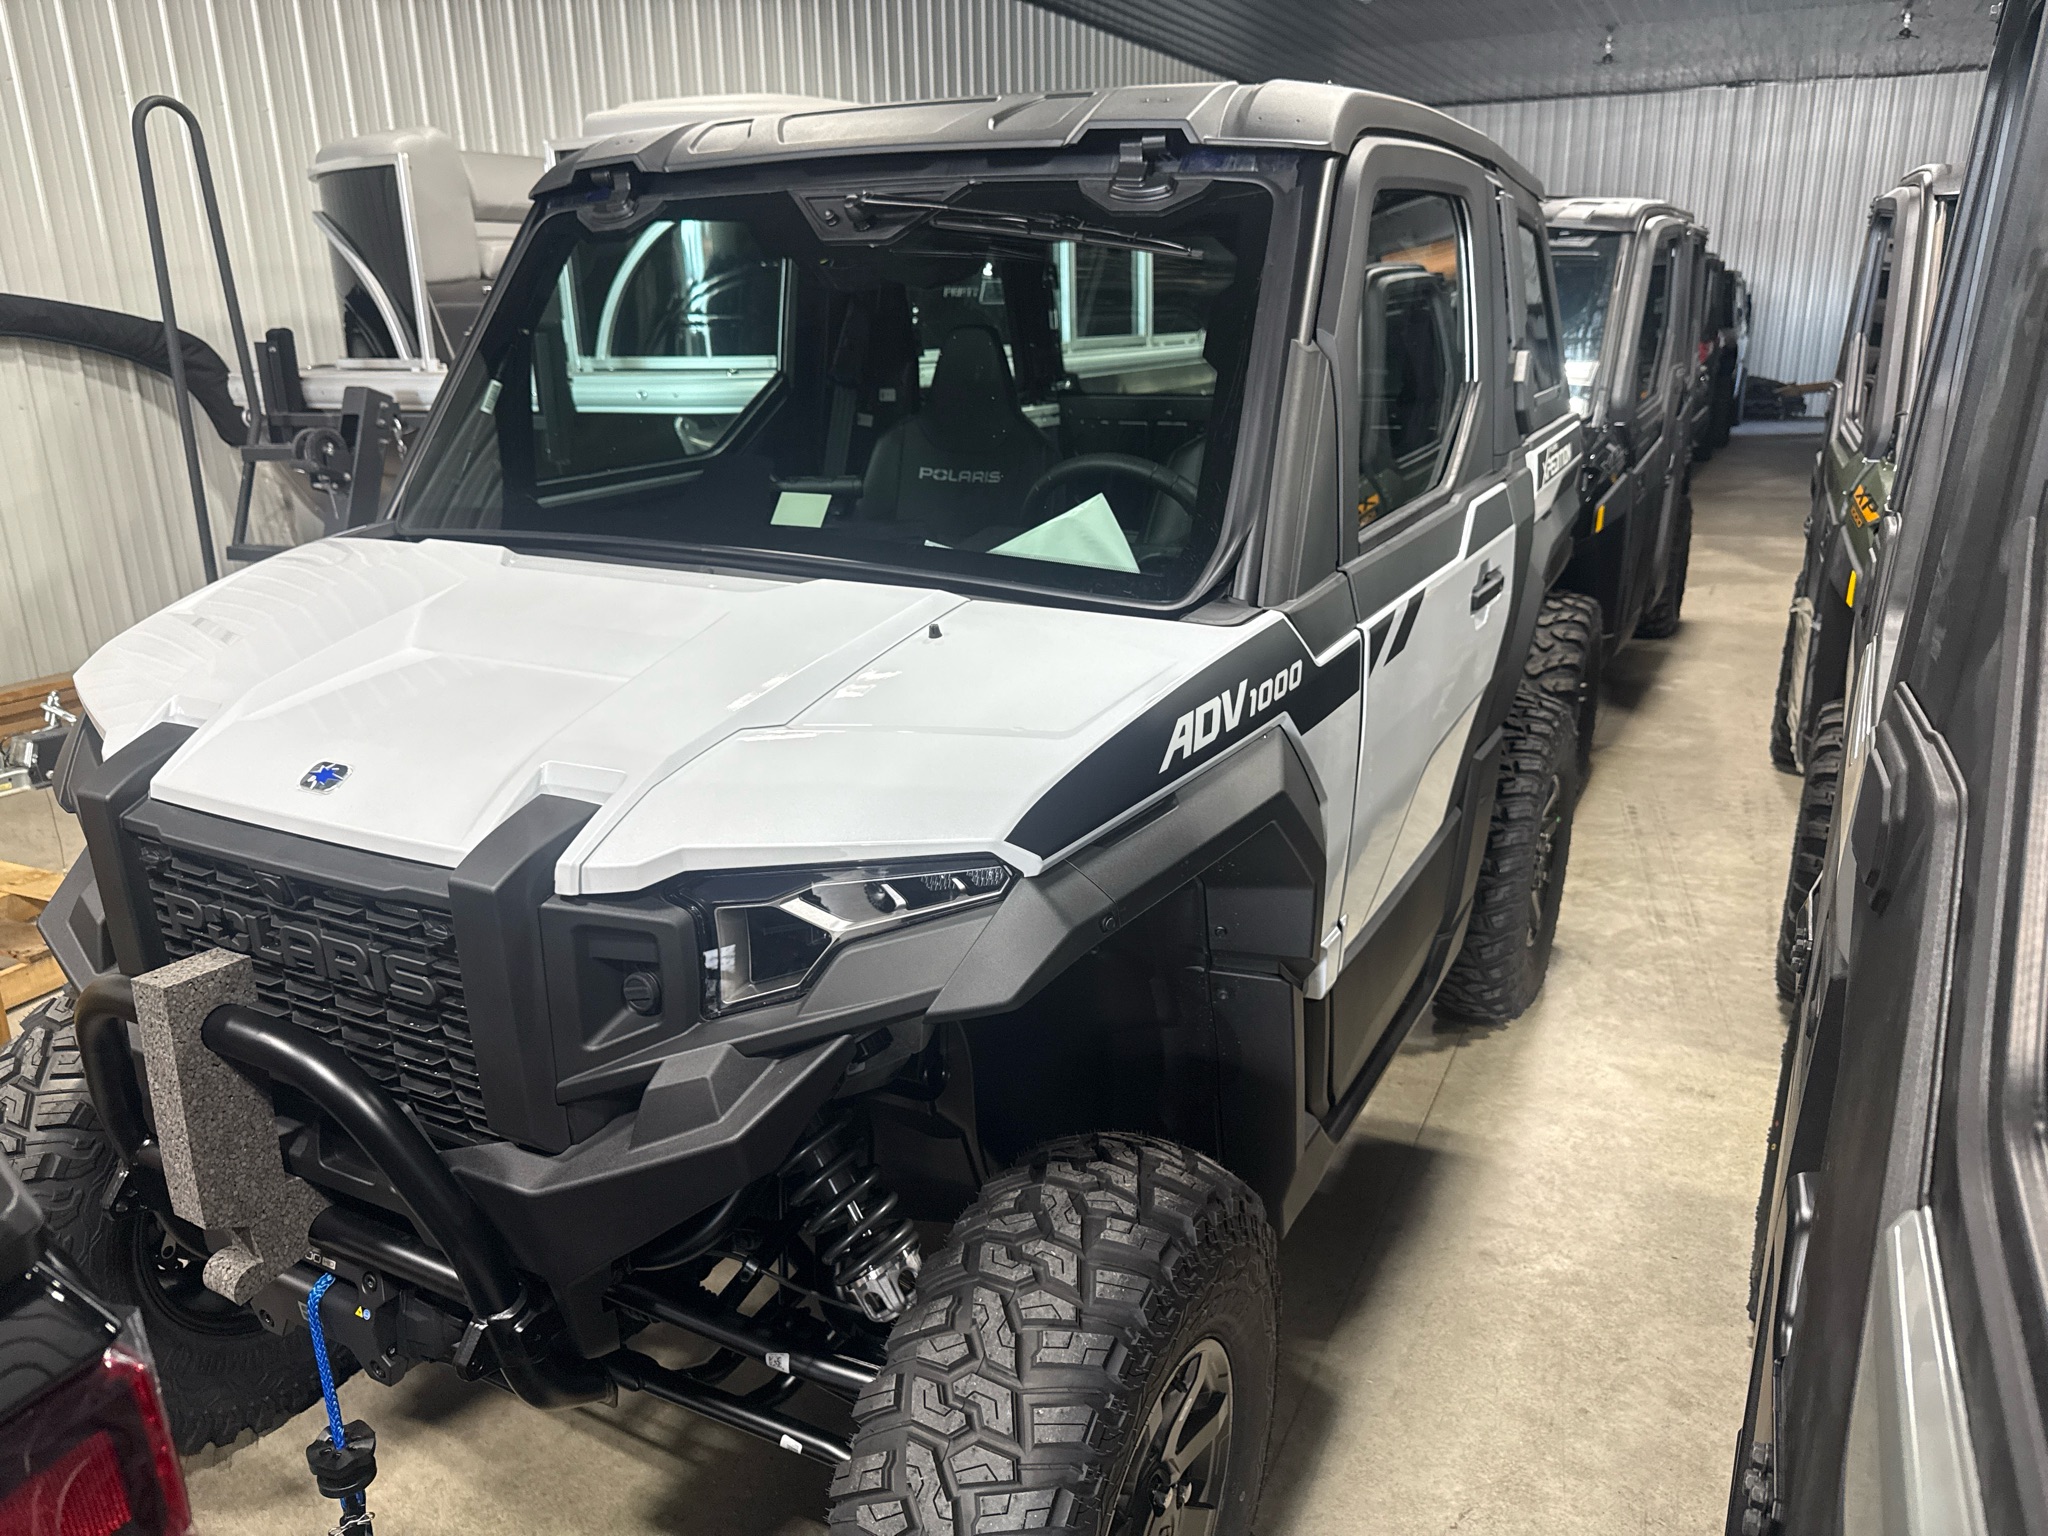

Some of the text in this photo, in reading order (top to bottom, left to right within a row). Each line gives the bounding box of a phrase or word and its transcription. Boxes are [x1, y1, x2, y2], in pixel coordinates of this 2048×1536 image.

[918, 466, 1001, 483] POLARIS
[1855, 486, 1879, 513] XP
[1158, 659, 1303, 775] ADV 1000
[162, 890, 441, 1006] POLARIS
